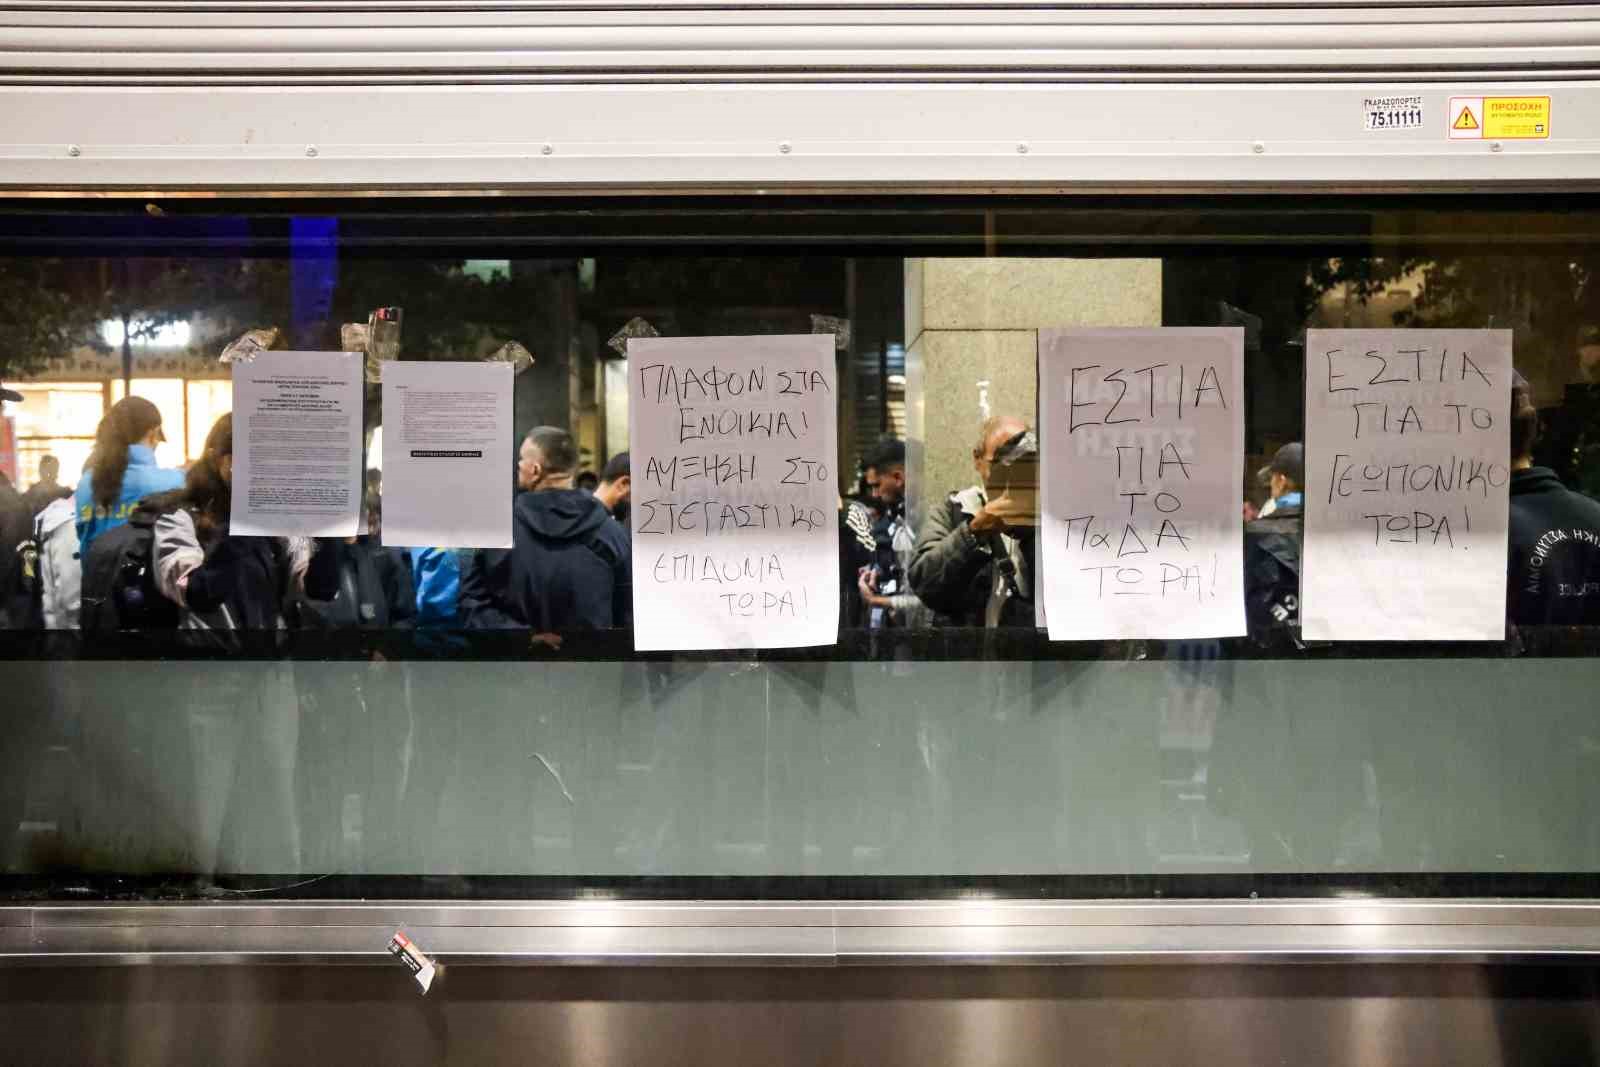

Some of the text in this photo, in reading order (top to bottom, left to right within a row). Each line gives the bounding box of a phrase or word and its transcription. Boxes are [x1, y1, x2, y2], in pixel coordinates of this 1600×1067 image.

[1370, 110, 1421, 126] 75.11111
[1491, 103, 1542, 111] ΠΡΟΣΟΧΗ
[639, 364, 830, 405] ΠΛΑΦΟΝ ΣΤΑ
[1326, 349, 1492, 393] ΕΣΤΙΑ
[1069, 364, 1227, 434] ΕΣΤΙΑ
[679, 407, 809, 444] ΕΝΟΙΚΙΑ!
[1352, 402, 1492, 439] ΓΙΑ ΤΟ
[646, 454, 829, 491] ΑΥΞΗΣΗ ΣΤΟ
[1115, 442, 1193, 485] ΓΙΑ
[1328, 454, 1510, 504] ΓΕΩΠΟΝΙΚΟ
[637, 500, 827, 536] ΣΤΕΓΑΣΤΙΚΟ
[1119, 492, 1183, 516] ΤΟ
[1364, 505, 1471, 550] ΤΩΡΑ!
[653, 553, 785, 584] ΕΠΙΔΟΜΑ
